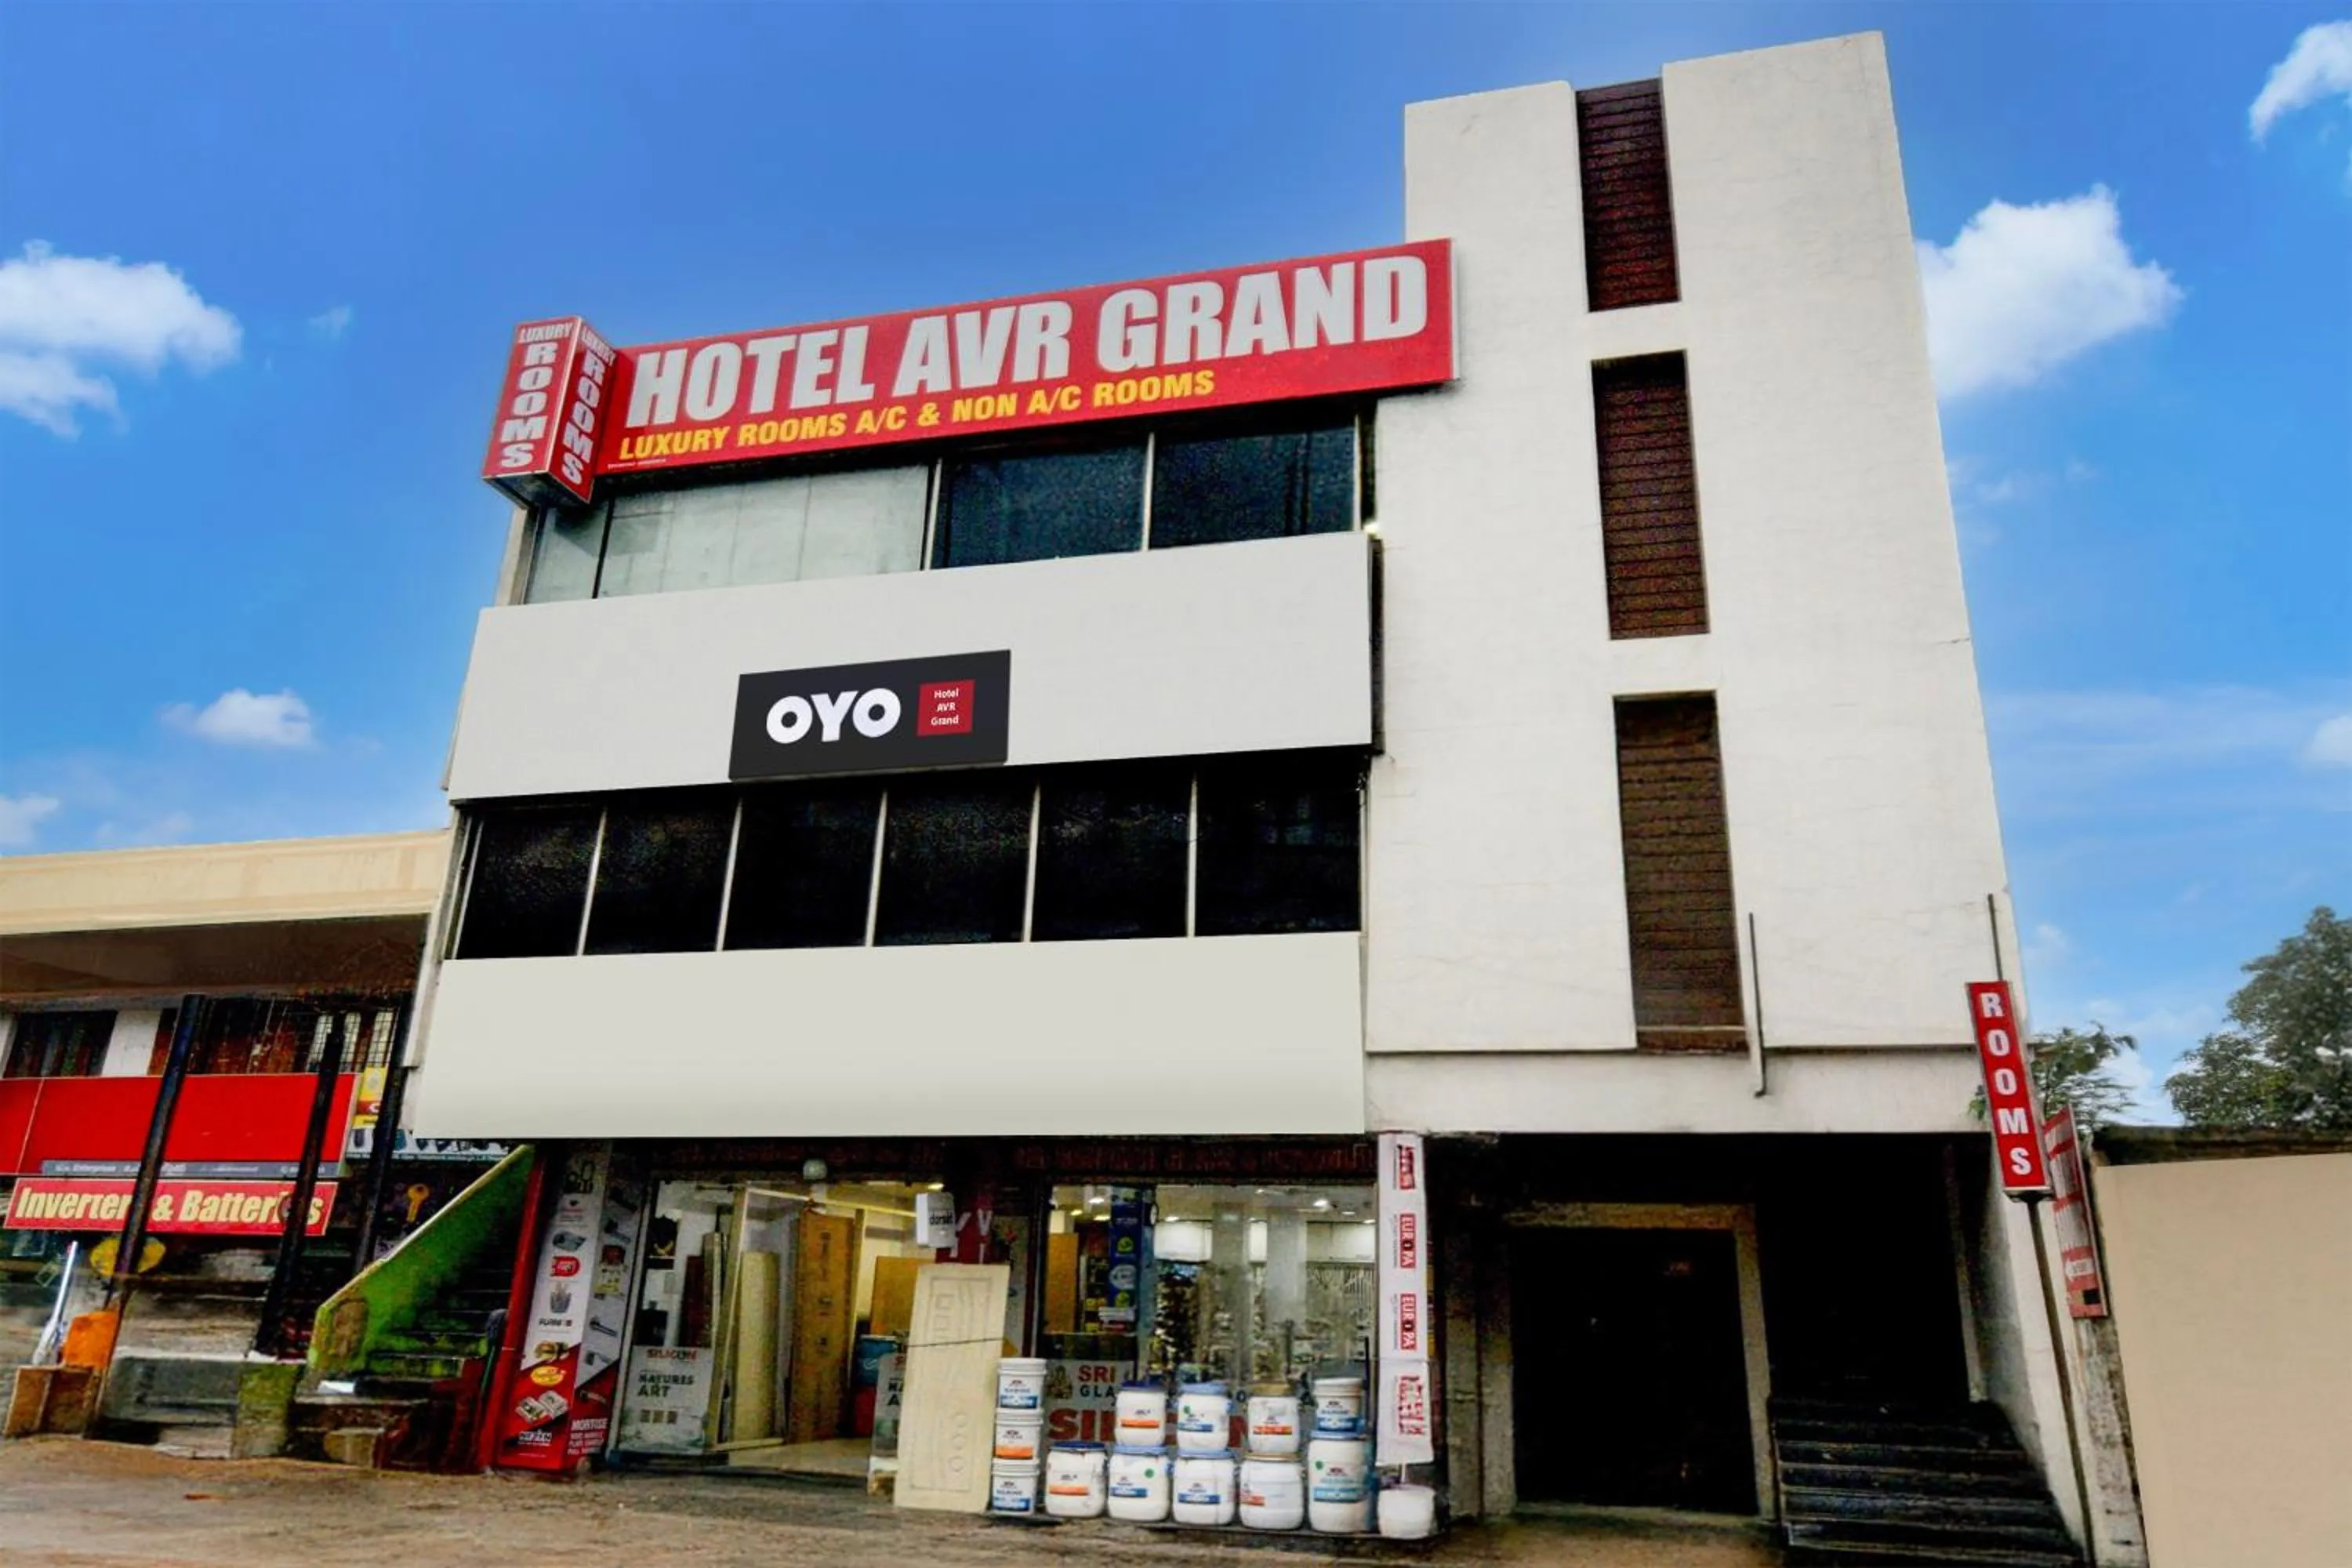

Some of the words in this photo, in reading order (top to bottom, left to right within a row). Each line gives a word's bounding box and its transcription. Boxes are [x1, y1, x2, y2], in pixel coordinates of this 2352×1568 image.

[518, 322, 574, 343] LUXURY
[581, 326, 616, 367] LUXURY
[626, 325, 875, 429] HOTEL
[892, 300, 1073, 397] AVR
[1097, 255, 1427, 372] GRAND
[499, 341, 558, 468] ROOMS
[561, 350, 605, 485] ROOMS
[619, 425, 731, 459] LUXURY
[737, 412, 847, 448] ROOMS
[855, 408, 907, 435] A/C
[917, 402, 941, 423] &
[952, 392, 1017, 423] NON
[1028, 385, 1082, 413] A/C
[1094, 369, 1215, 408] ROOMS
[934, 688, 960, 699] Hotel
[936, 702, 956, 712] AVR
[766, 688, 901, 744] OYO
[931, 714, 960, 726] Grand
[1980, 992, 2032, 1176] ROOMS
[152, 1194, 173, 1221] &
[178, 1189, 324, 1226] Batteris
[1401, 1214, 1416, 1268] EUROPA
[1401, 1294, 1417, 1350] EUROPA
[637, 1385, 671, 1397] ART
[1078, 1365, 1116, 1383] SRI
[1080, 1385, 1117, 1398] GLA
